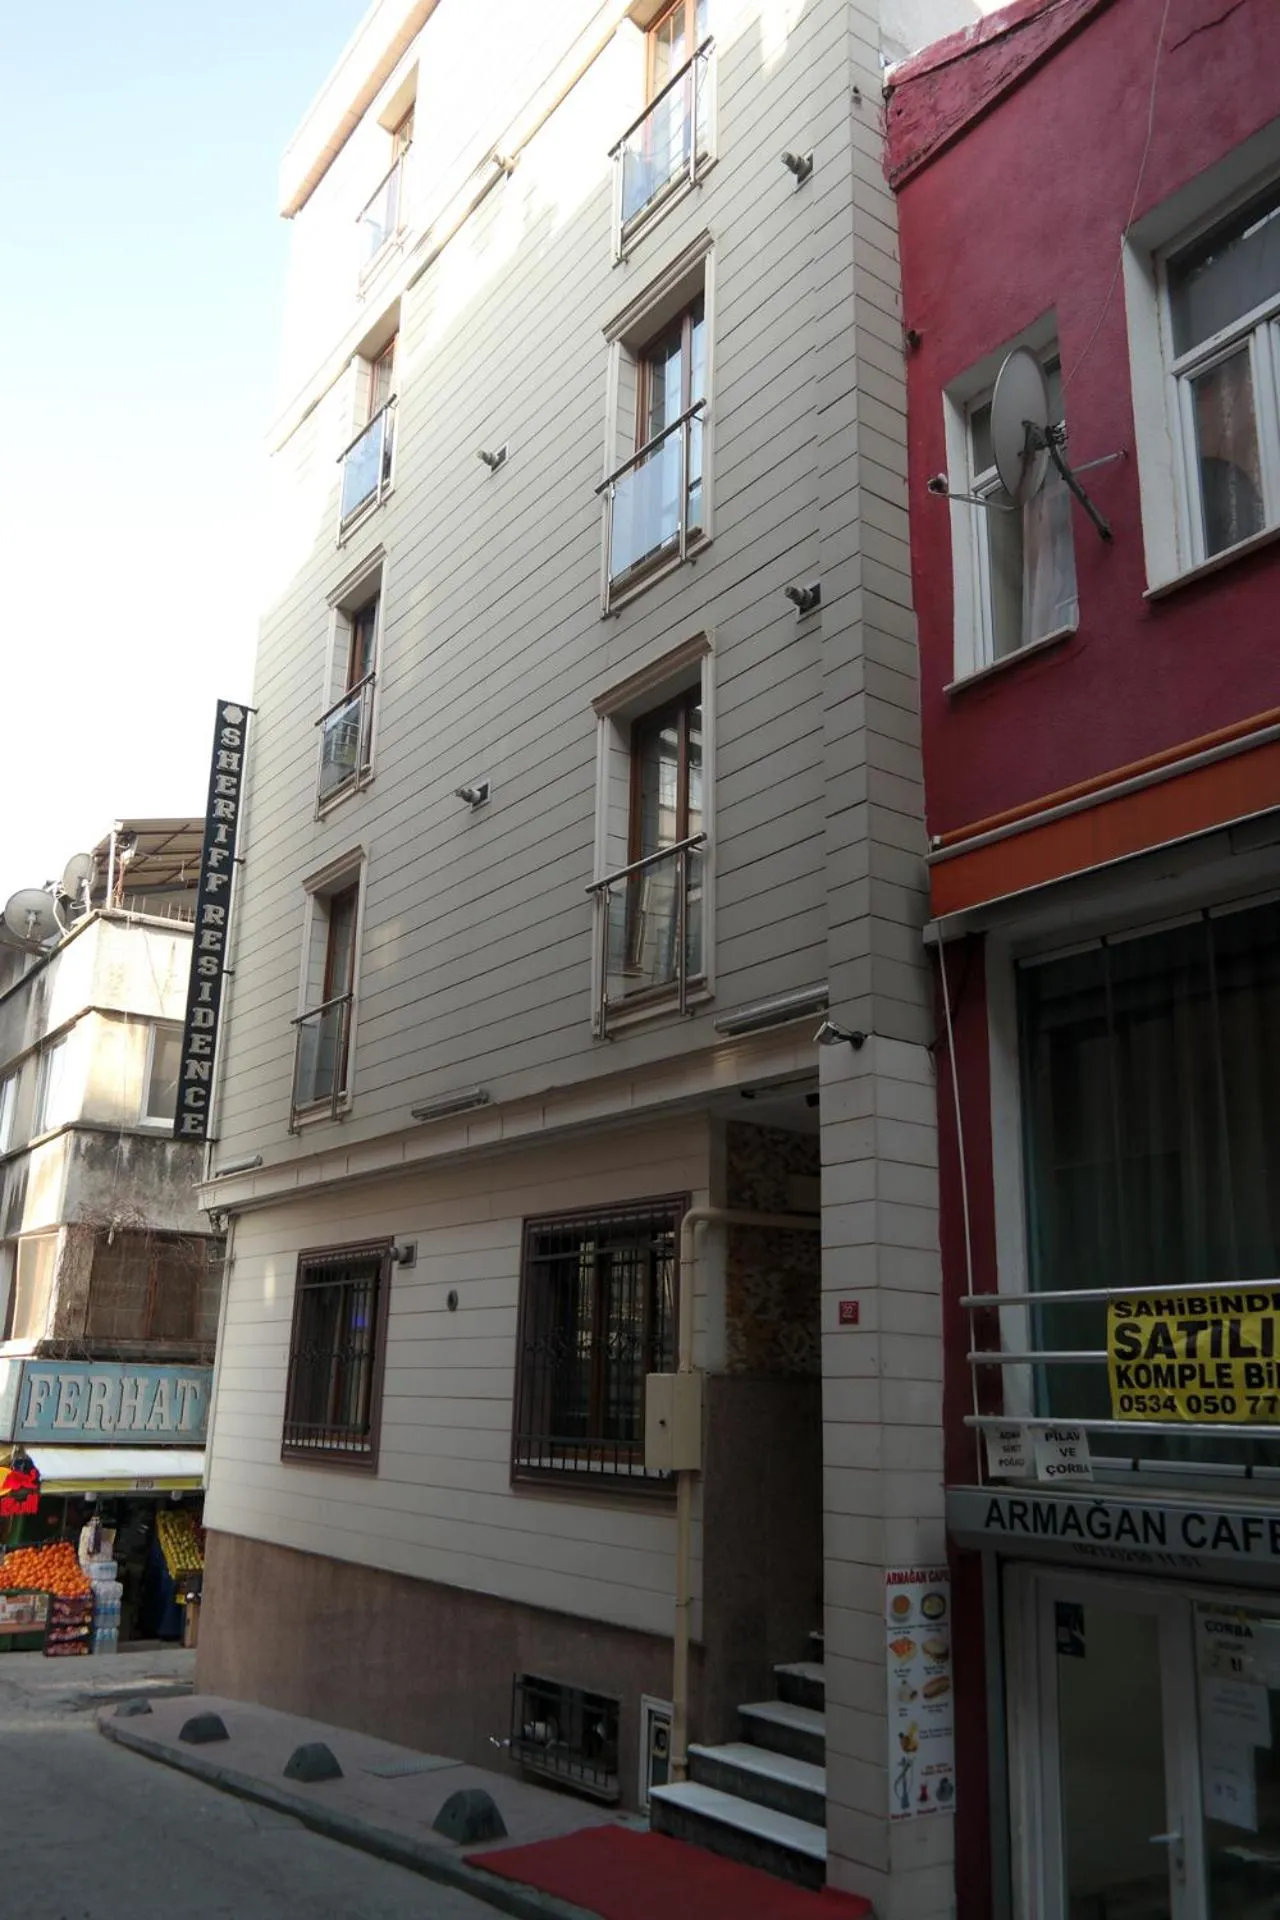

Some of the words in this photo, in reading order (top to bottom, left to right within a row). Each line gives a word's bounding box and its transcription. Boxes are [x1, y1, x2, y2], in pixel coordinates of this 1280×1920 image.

[205, 727, 242, 892] SHERIFF
[180, 903, 225, 1134] RESIDENCE
[1116, 1363, 1234, 1389] KOMPLE
[22, 1374, 201, 1432] FERHAT
[1120, 1395, 1177, 1413] 0534
[1186, 1395, 1236, 1414] 050
[1059, 1447, 1076, 1457] VE
[984, 1498, 1167, 1546] ARMAĞAN
